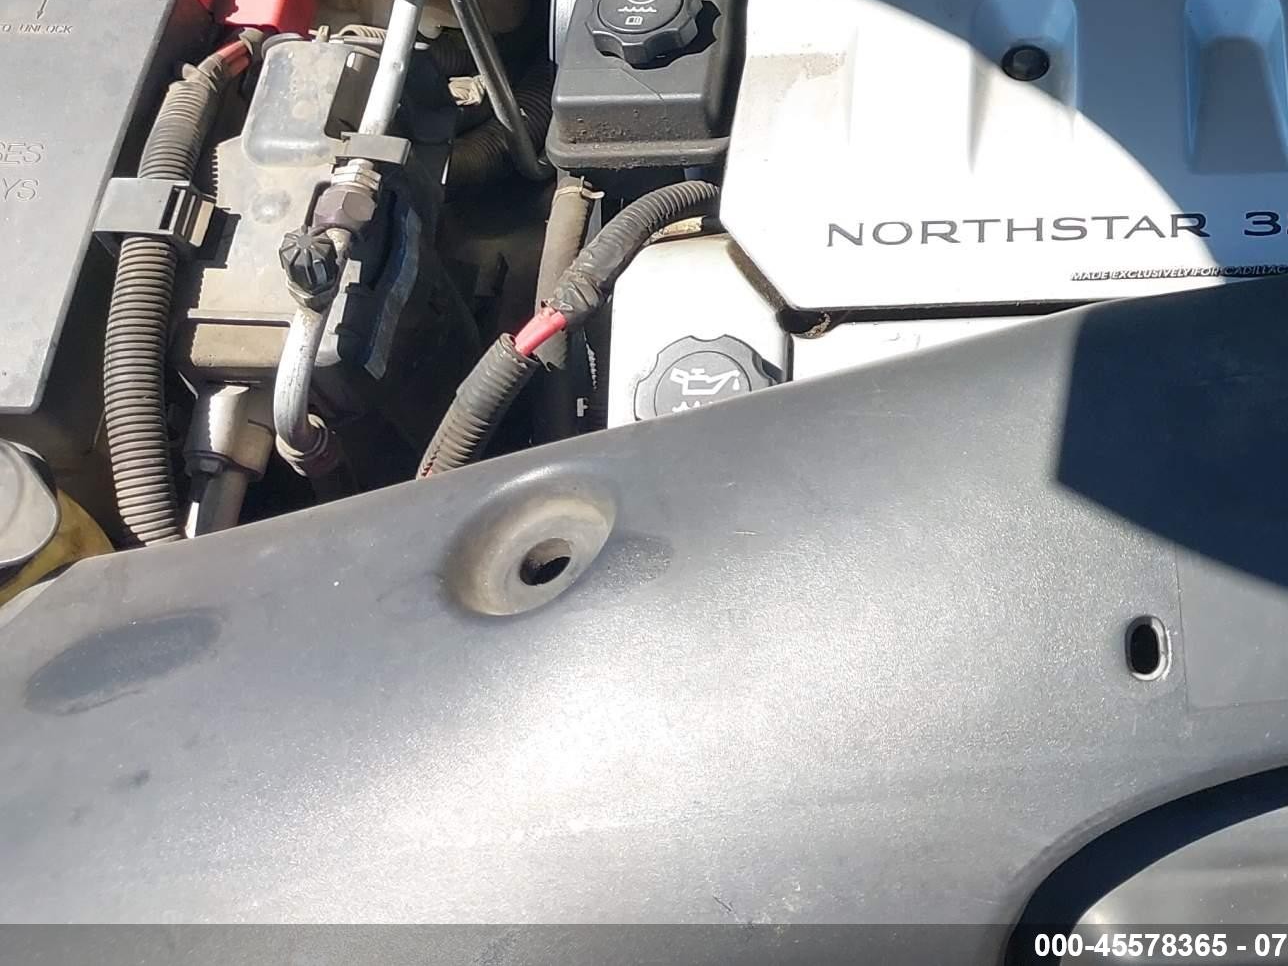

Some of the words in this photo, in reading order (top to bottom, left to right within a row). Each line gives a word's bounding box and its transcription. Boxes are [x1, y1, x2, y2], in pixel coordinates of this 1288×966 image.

[826, 212, 1211, 247] NORTHSTAR
[1071, 272, 1110, 281] MADE
[1111, 267, 1191, 280] EXCLUSIVELY
[1191, 266, 1220, 277] FOR
[1223, 264, 1287, 275] CADILLAC
